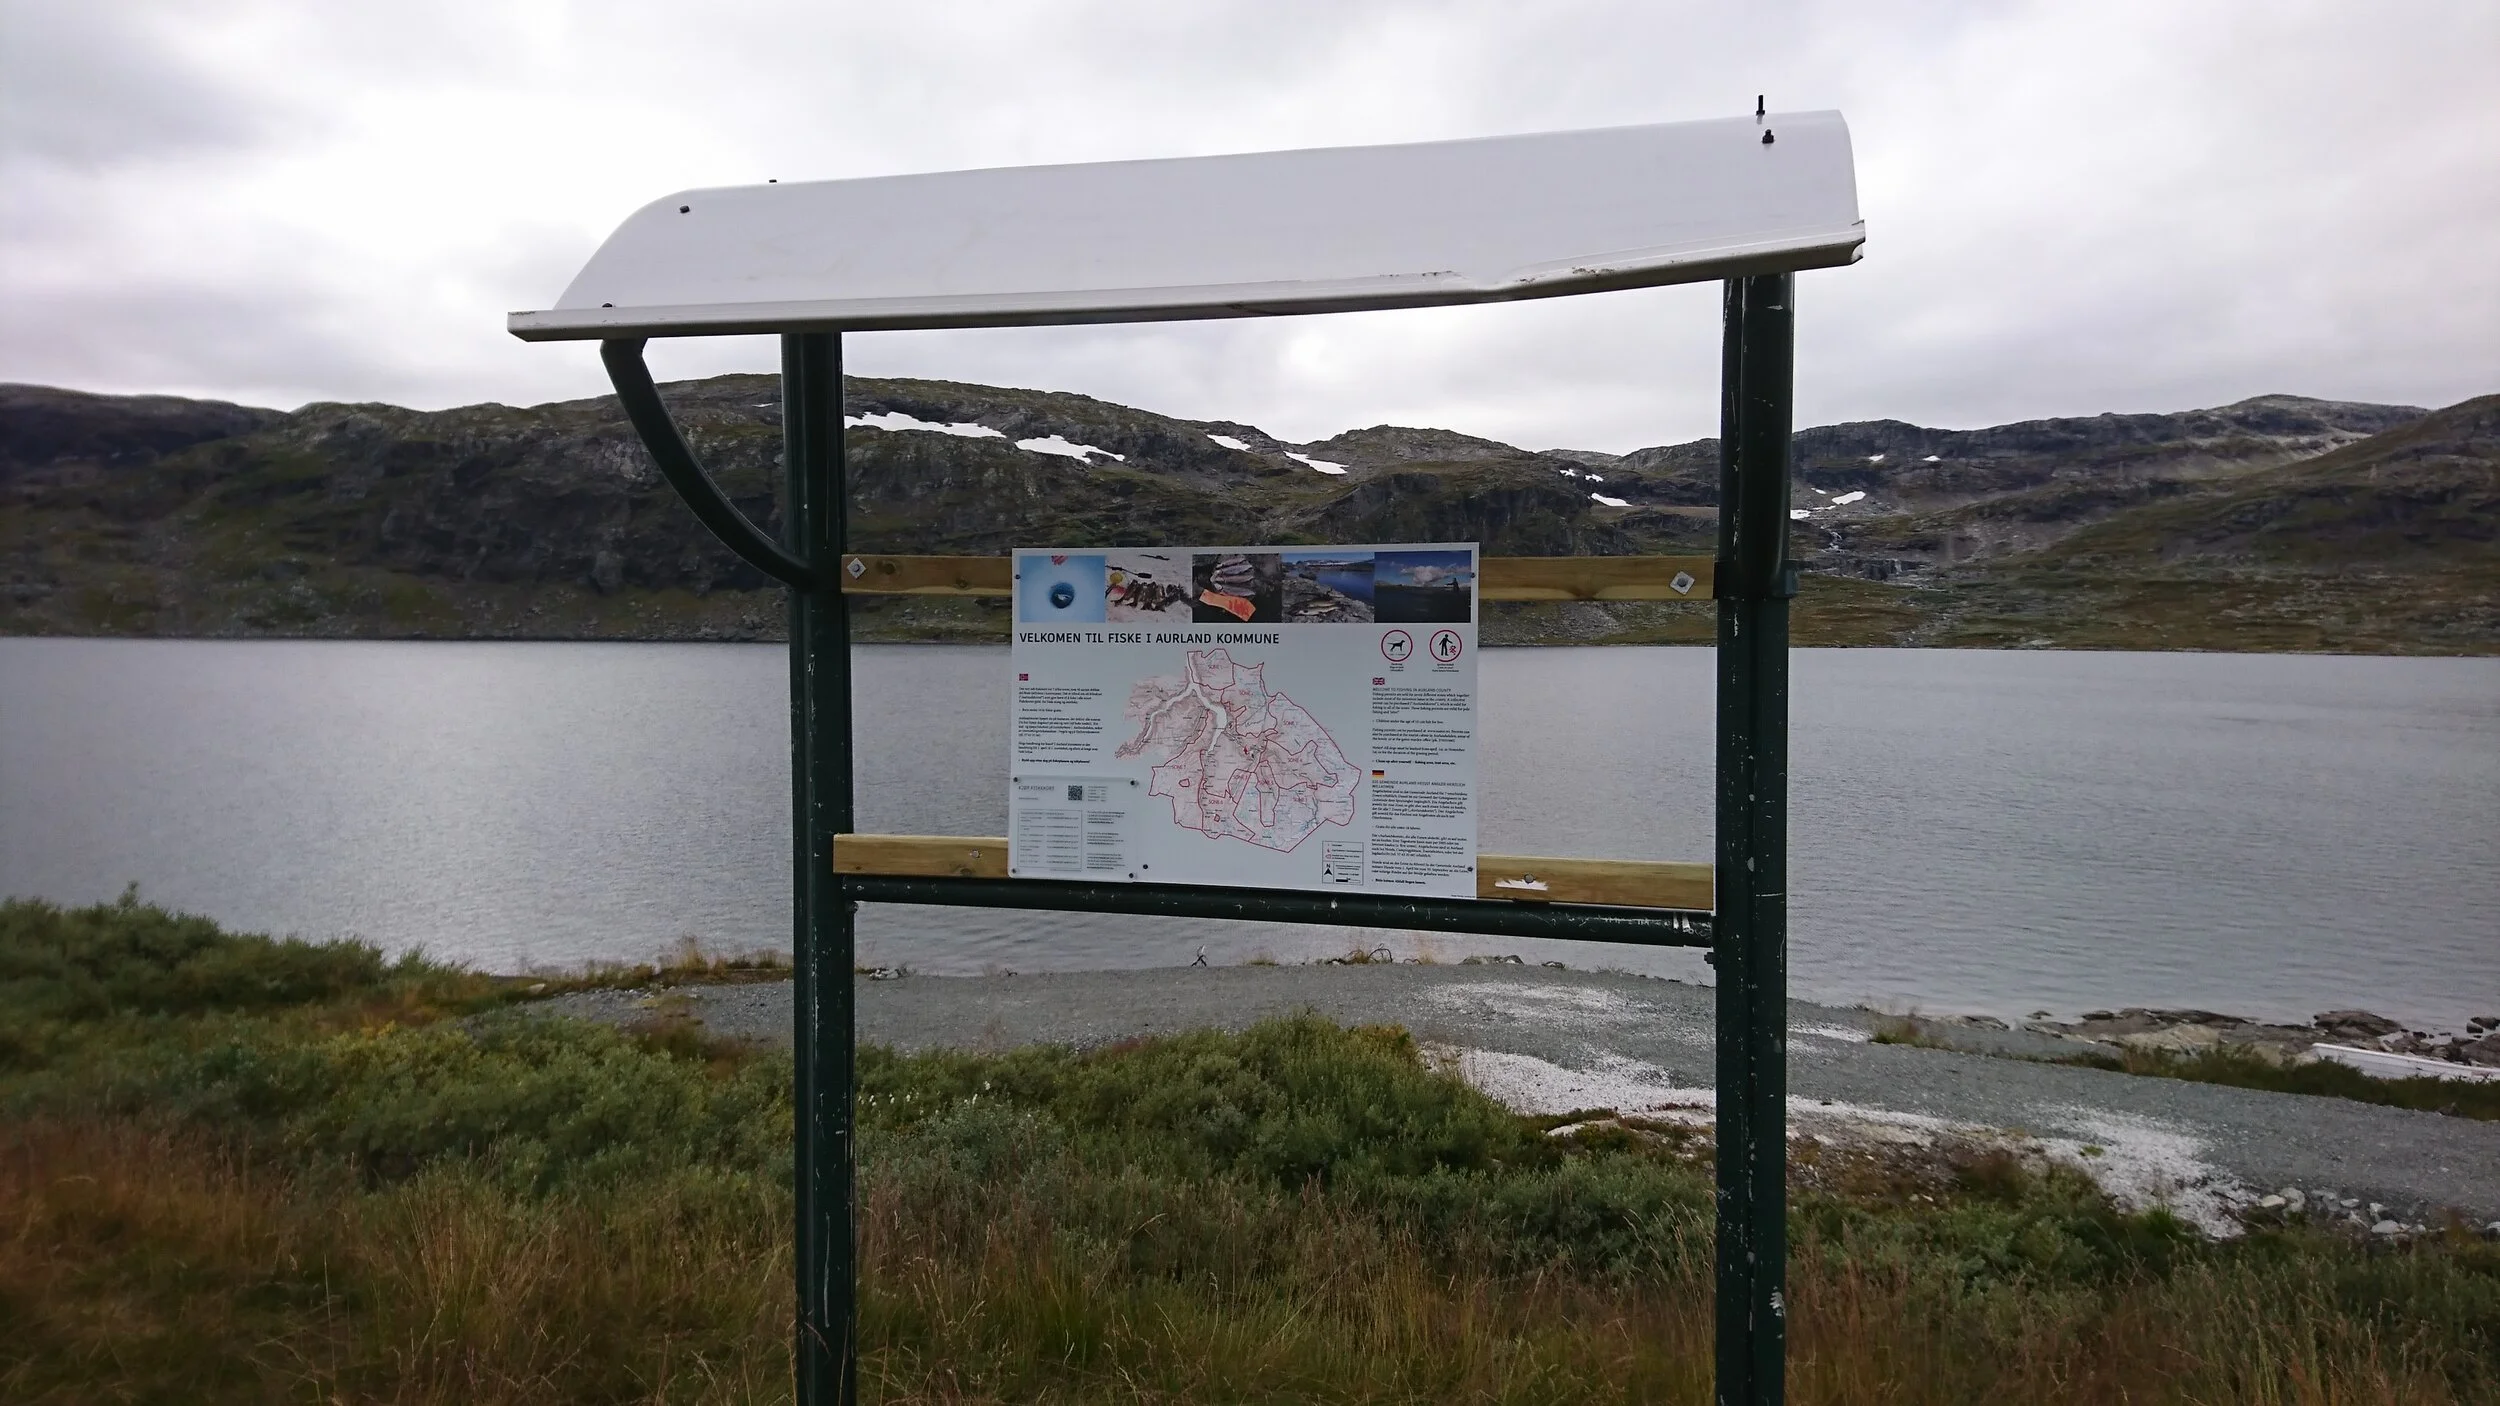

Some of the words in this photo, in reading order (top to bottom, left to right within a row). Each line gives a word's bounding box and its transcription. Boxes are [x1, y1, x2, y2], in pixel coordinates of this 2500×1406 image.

[1019, 632, 1081, 644] VELKOMEN
[1085, 632, 1104, 644] TIL
[1108, 632, 1142, 644] FISKE
[1145, 633, 1151, 644] I
[1155, 633, 1212, 645] AURLAND
[1216, 633, 1280, 645] KOMMUNE
